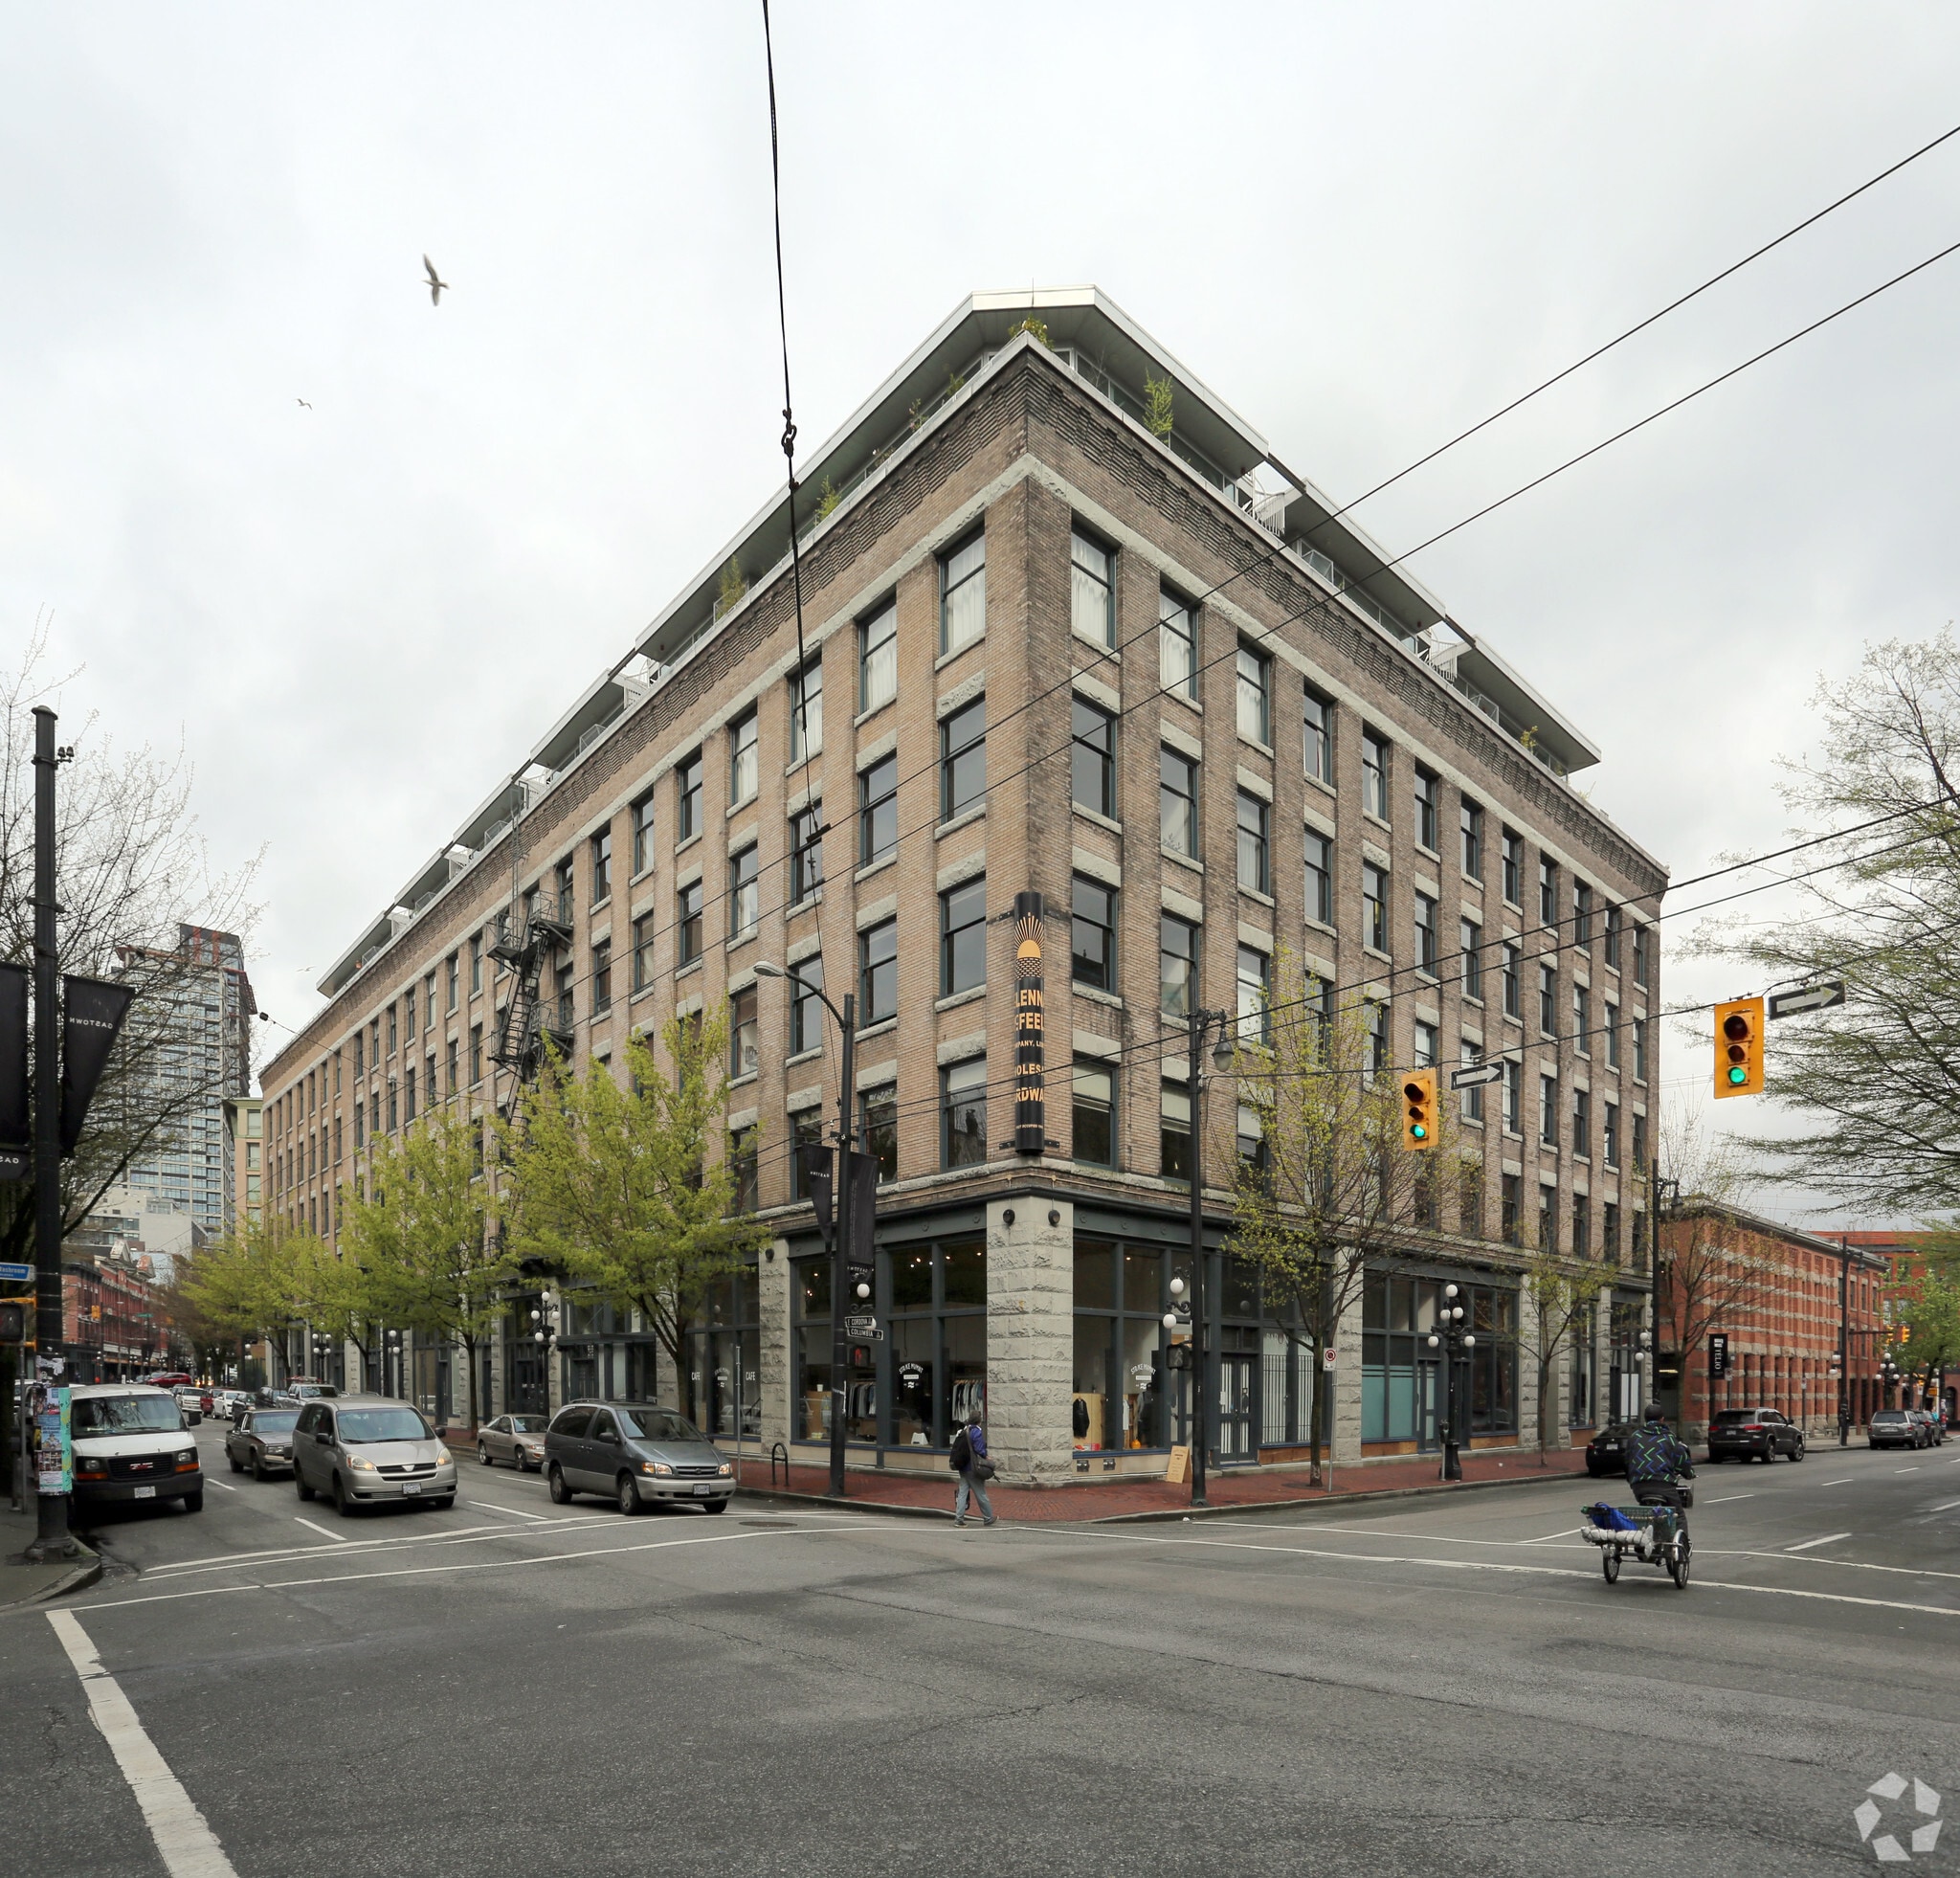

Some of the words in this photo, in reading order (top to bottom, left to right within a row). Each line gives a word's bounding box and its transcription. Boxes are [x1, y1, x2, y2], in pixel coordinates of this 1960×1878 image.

[851, 1328, 874, 1337] COLUMBIA
[691, 1371, 701, 1381] CAFE
[746, 1371, 756, 1381] CAFE
